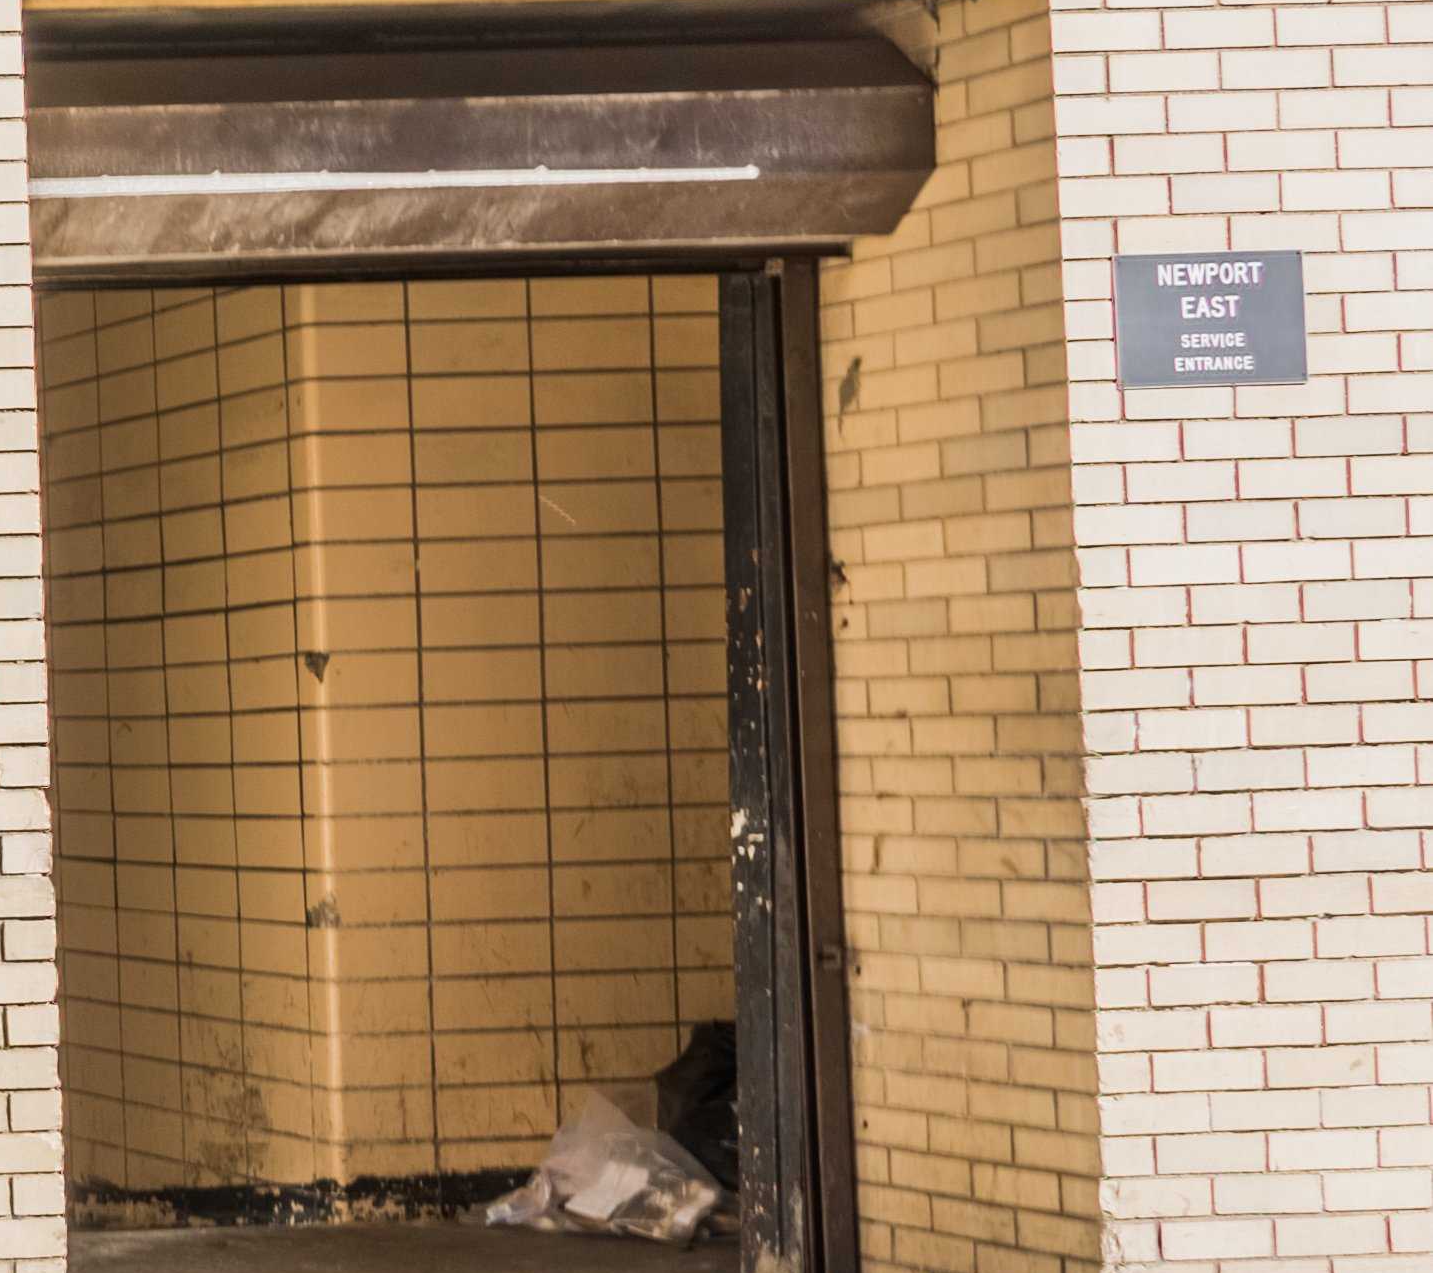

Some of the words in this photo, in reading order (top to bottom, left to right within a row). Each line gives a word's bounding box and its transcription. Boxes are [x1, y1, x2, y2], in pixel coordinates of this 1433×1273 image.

[1157, 261, 1264, 287] NEWPORT
[1180, 295, 1240, 319] EAST
[1180, 332, 1247, 349] SERVICE
[1173, 355, 1255, 373] ENTRANCE
